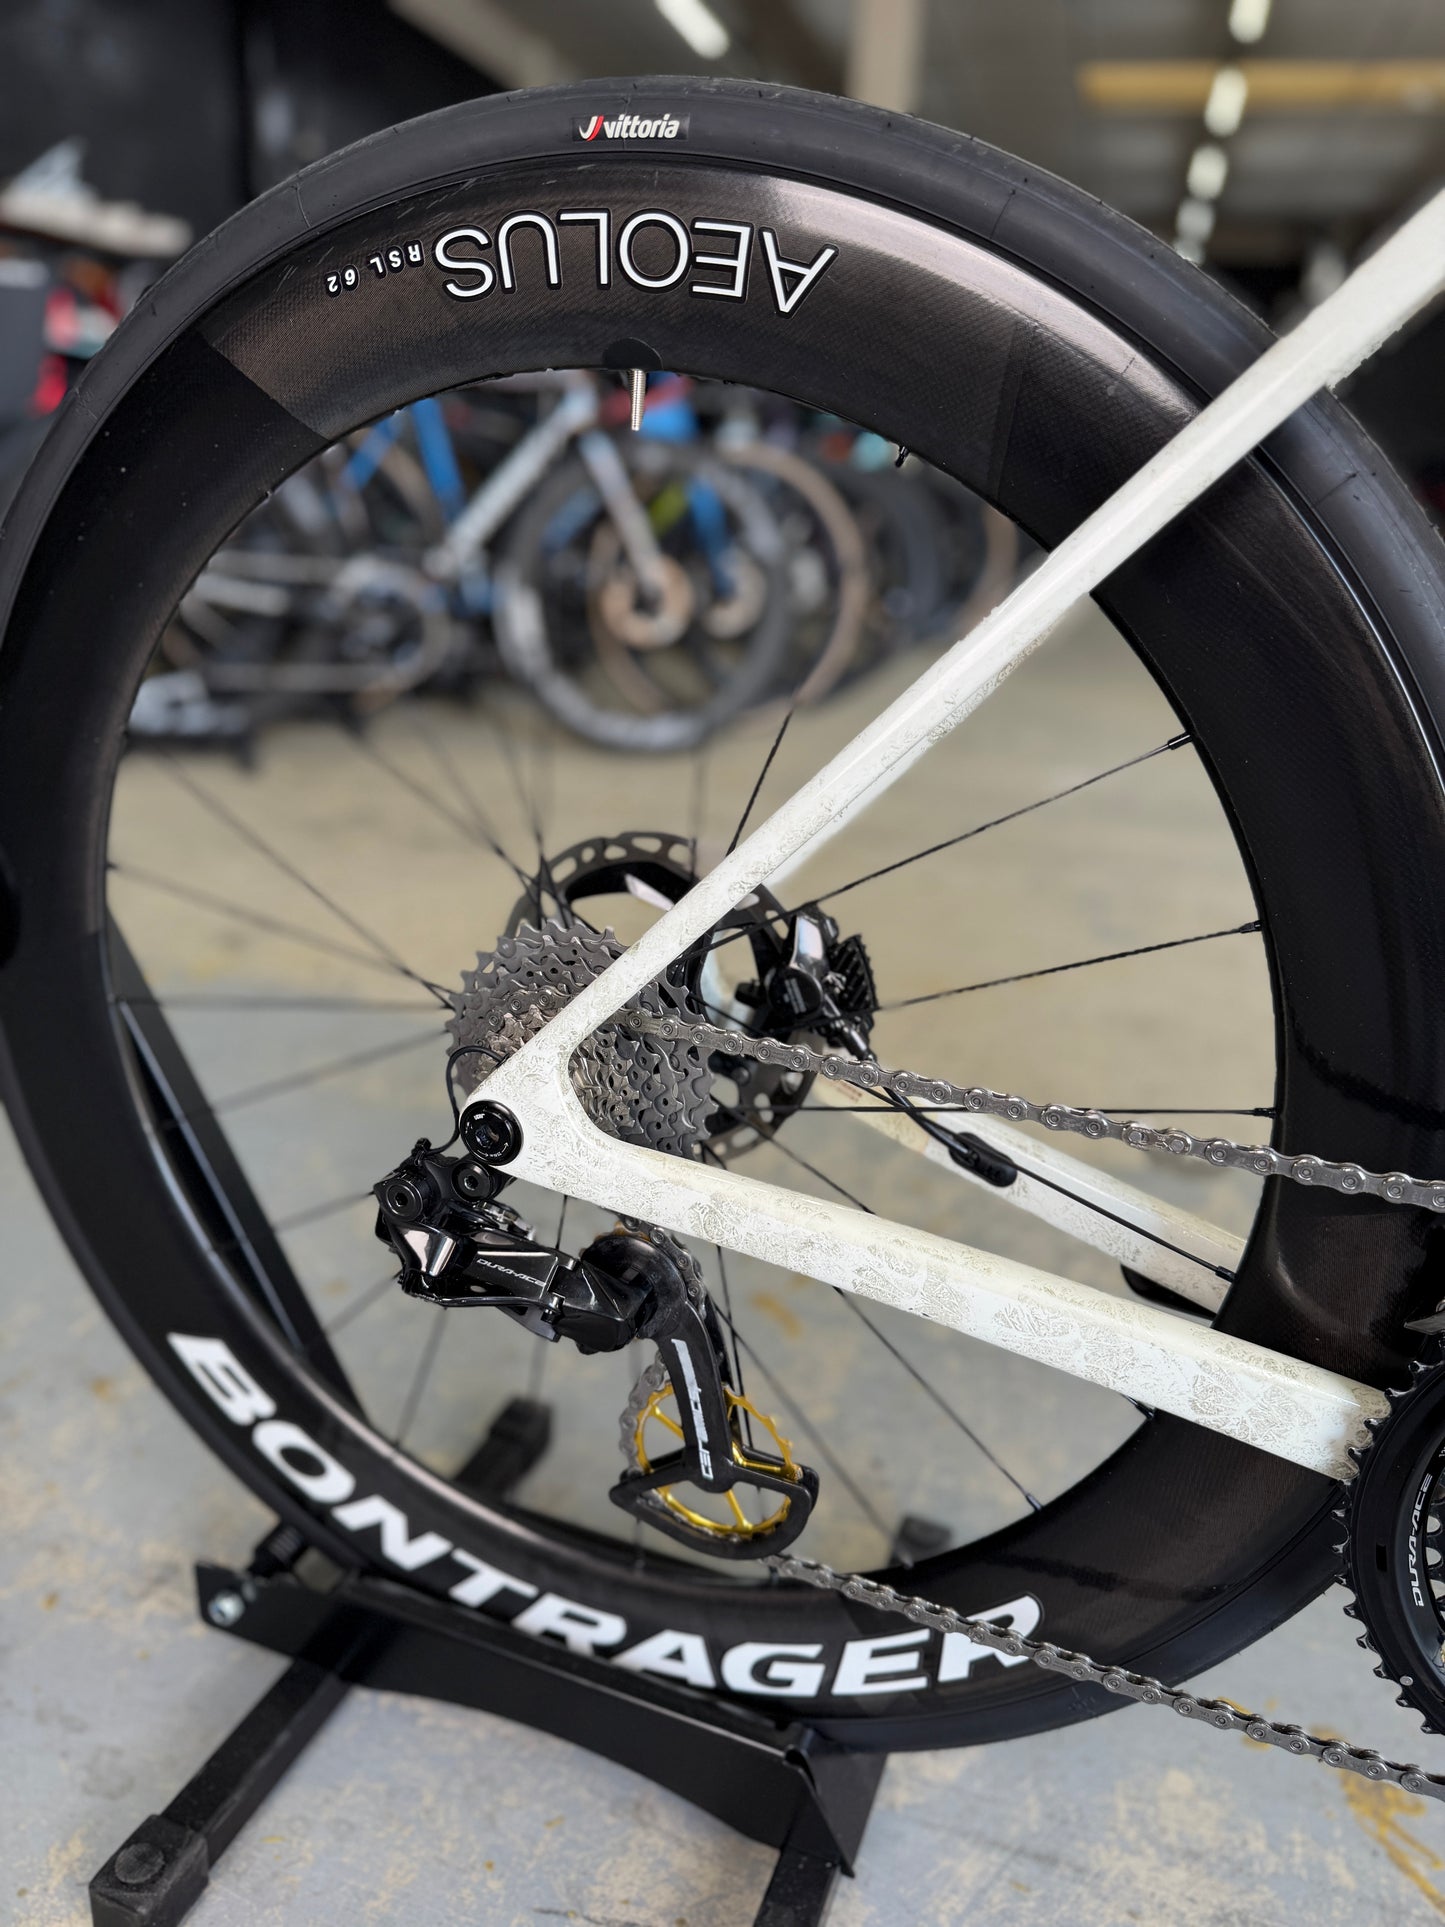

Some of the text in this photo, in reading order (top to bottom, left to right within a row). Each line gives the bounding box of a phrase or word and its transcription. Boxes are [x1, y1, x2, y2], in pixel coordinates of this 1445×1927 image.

[603, 113, 681, 139] vittoria
[326, 211, 836, 314] AEOLUS RSL 62
[165, 1331, 1041, 1697] BONTRAGER
[1408, 1472, 1433, 1607] DURA-ACE
